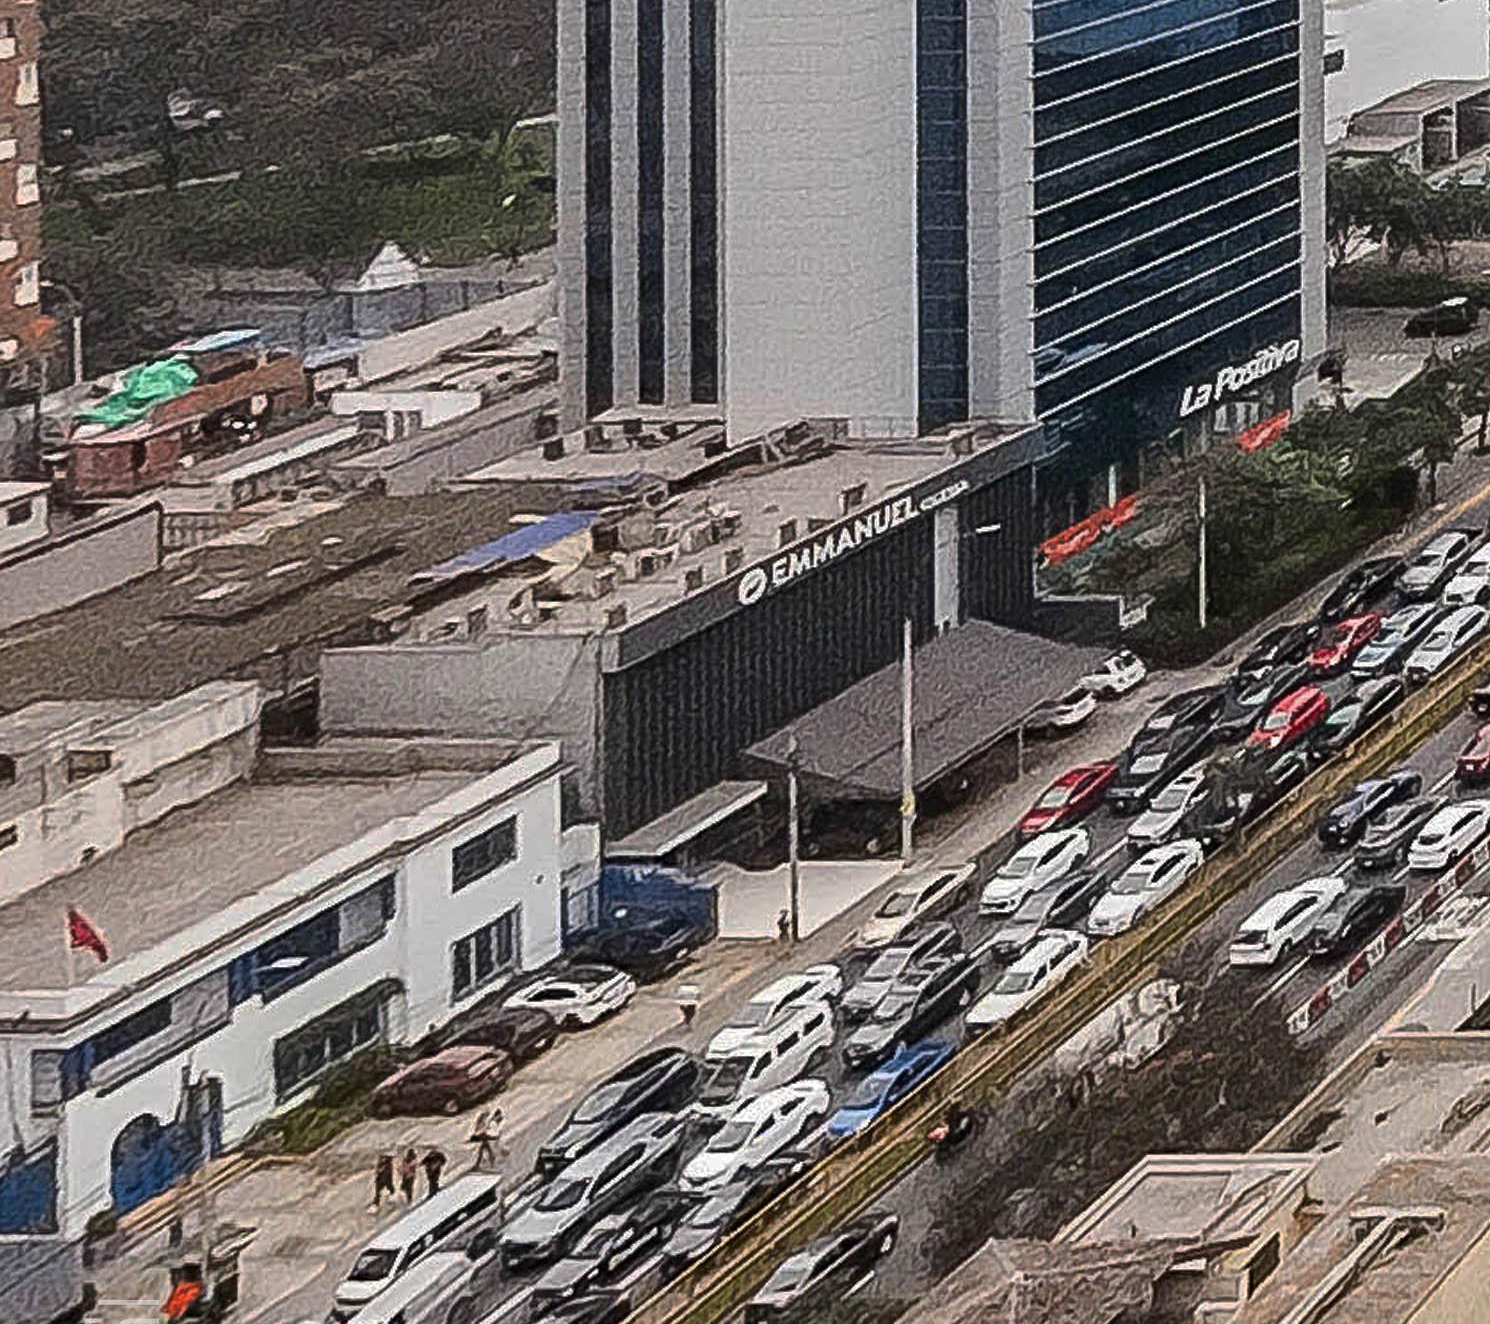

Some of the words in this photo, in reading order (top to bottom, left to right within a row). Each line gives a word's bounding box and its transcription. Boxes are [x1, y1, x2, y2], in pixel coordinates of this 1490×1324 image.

[1179, 384, 1213, 418] La
[1213, 339, 1300, 402] Positiva
[772, 495, 920, 589] EMMANUEL
